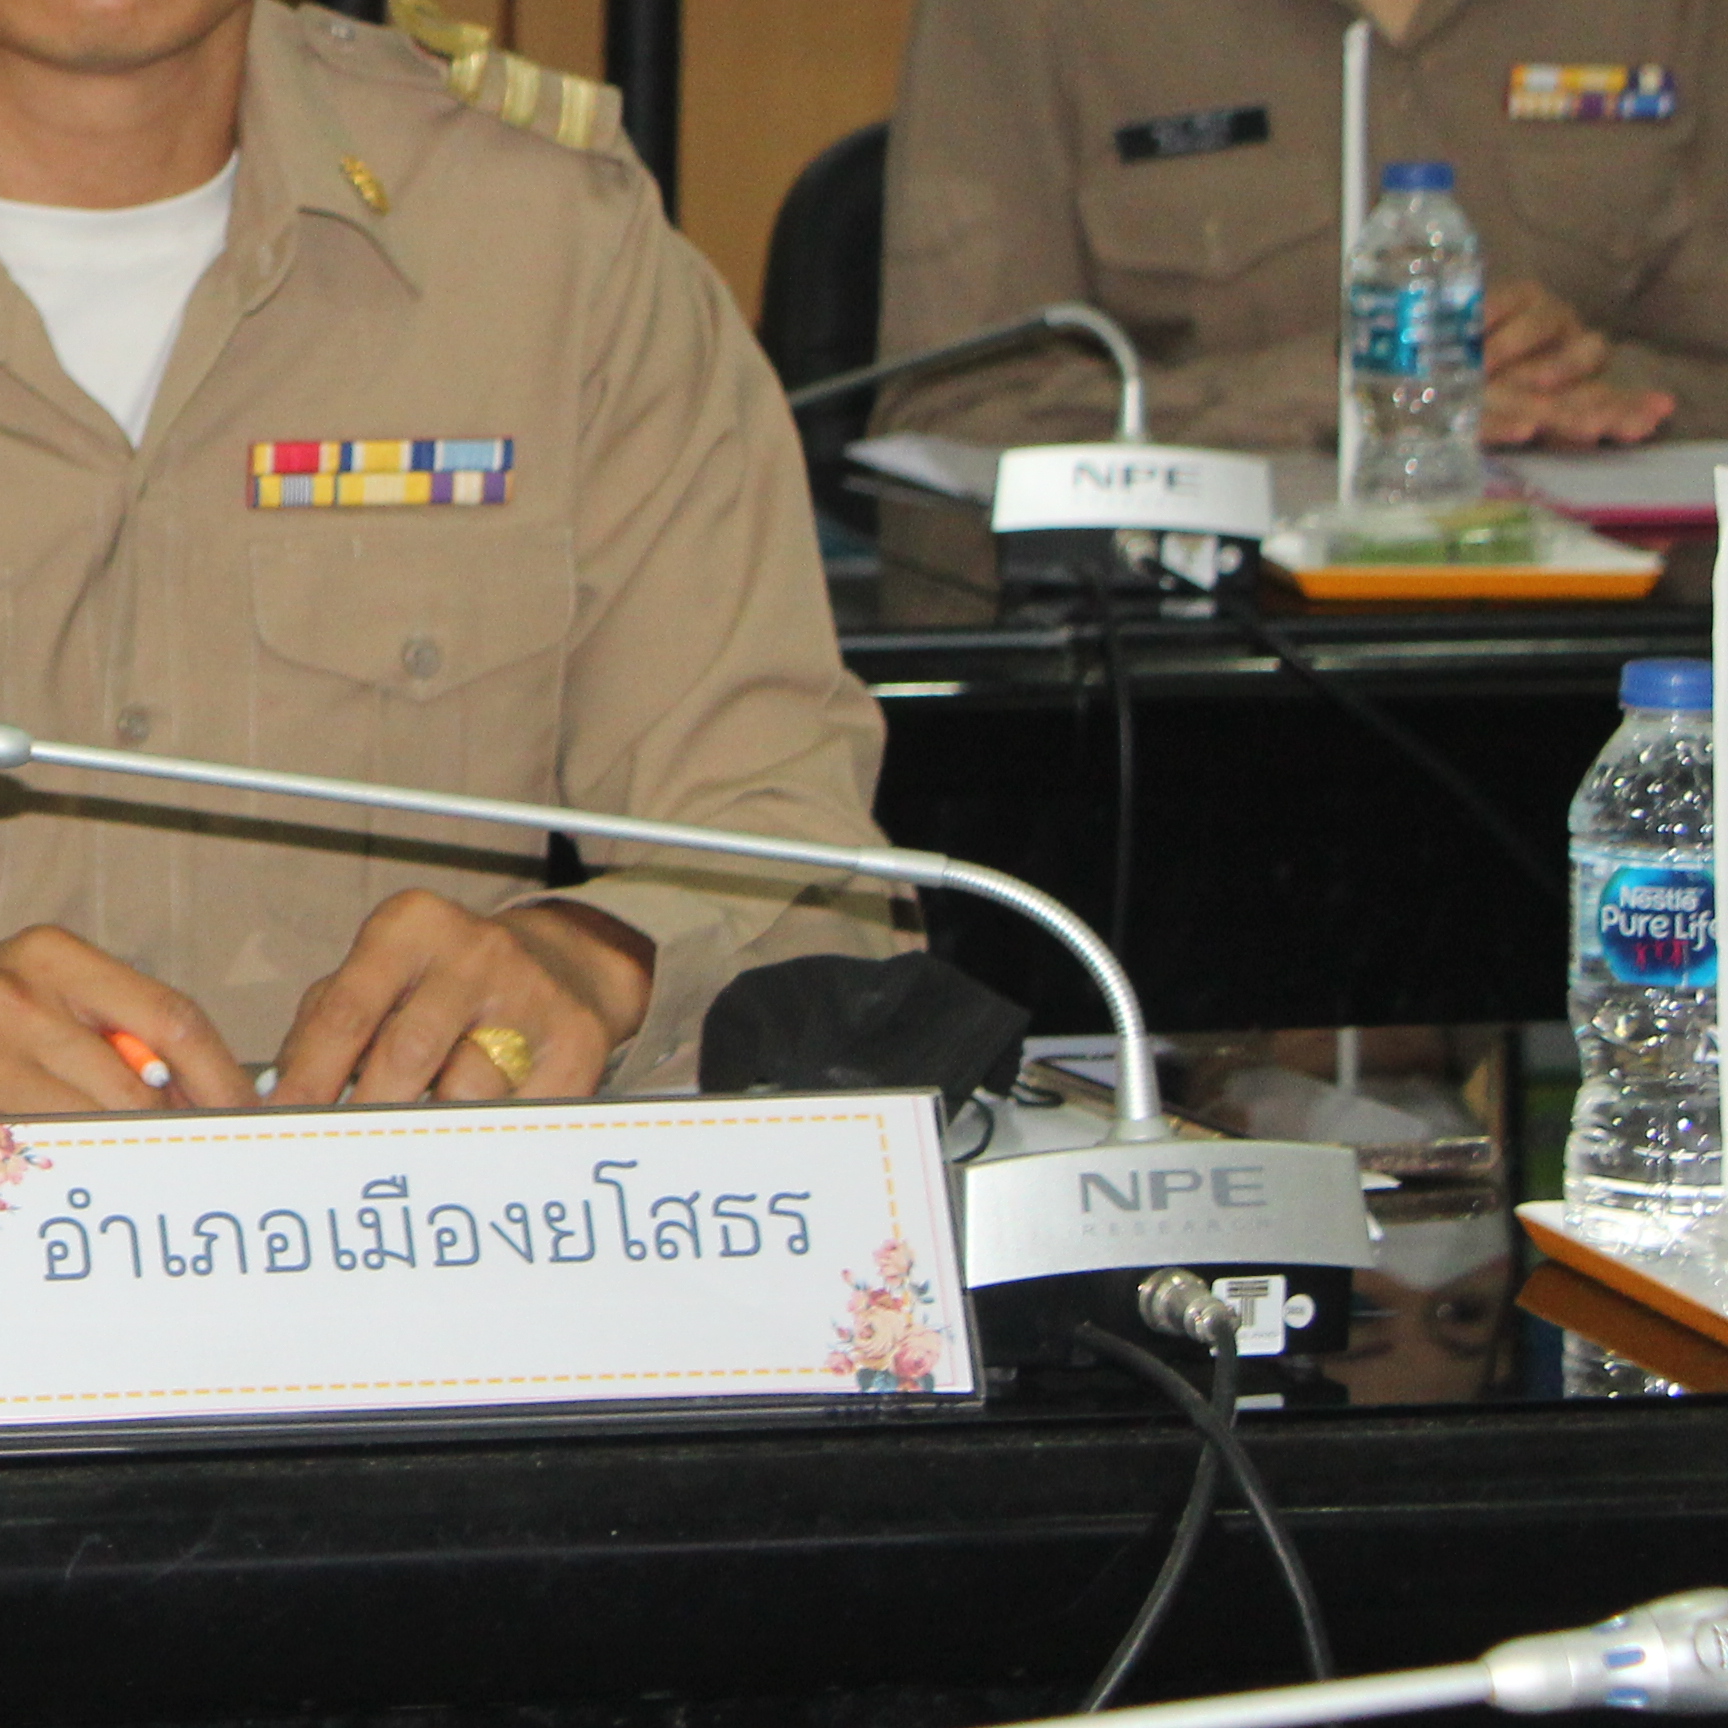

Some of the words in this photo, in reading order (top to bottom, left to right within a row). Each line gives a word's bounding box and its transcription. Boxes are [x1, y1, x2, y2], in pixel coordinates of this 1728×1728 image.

[1601, 903, 1671, 940] Pure
[1078, 1165, 1268, 1214] NPE
[37, 1158, 813, 1282] อำเภอเมืองยโสธร
